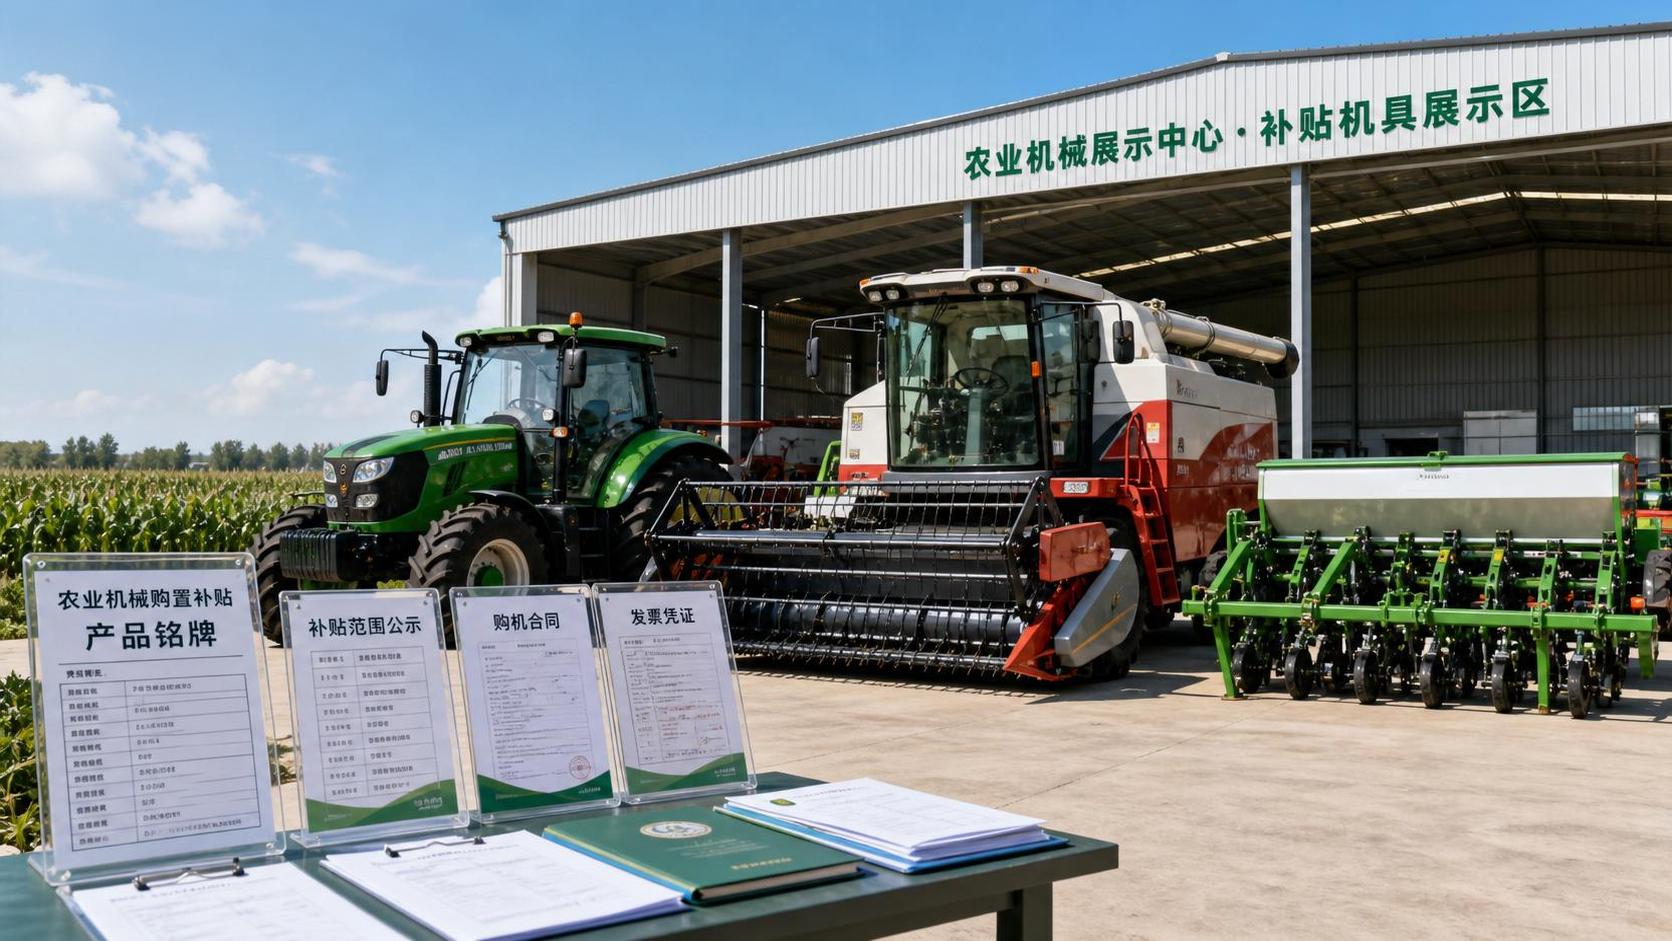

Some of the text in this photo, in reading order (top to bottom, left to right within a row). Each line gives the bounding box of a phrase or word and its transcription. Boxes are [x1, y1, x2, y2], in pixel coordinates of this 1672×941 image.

[57, 588, 233, 611] 农业机械购置补贴
[308, 616, 422, 638] 补贴范围公示
[493, 612, 560, 632] 购机合同
[631, 607, 696, 626] 发票凭证
[85, 619, 217, 651] 产品铭牌
